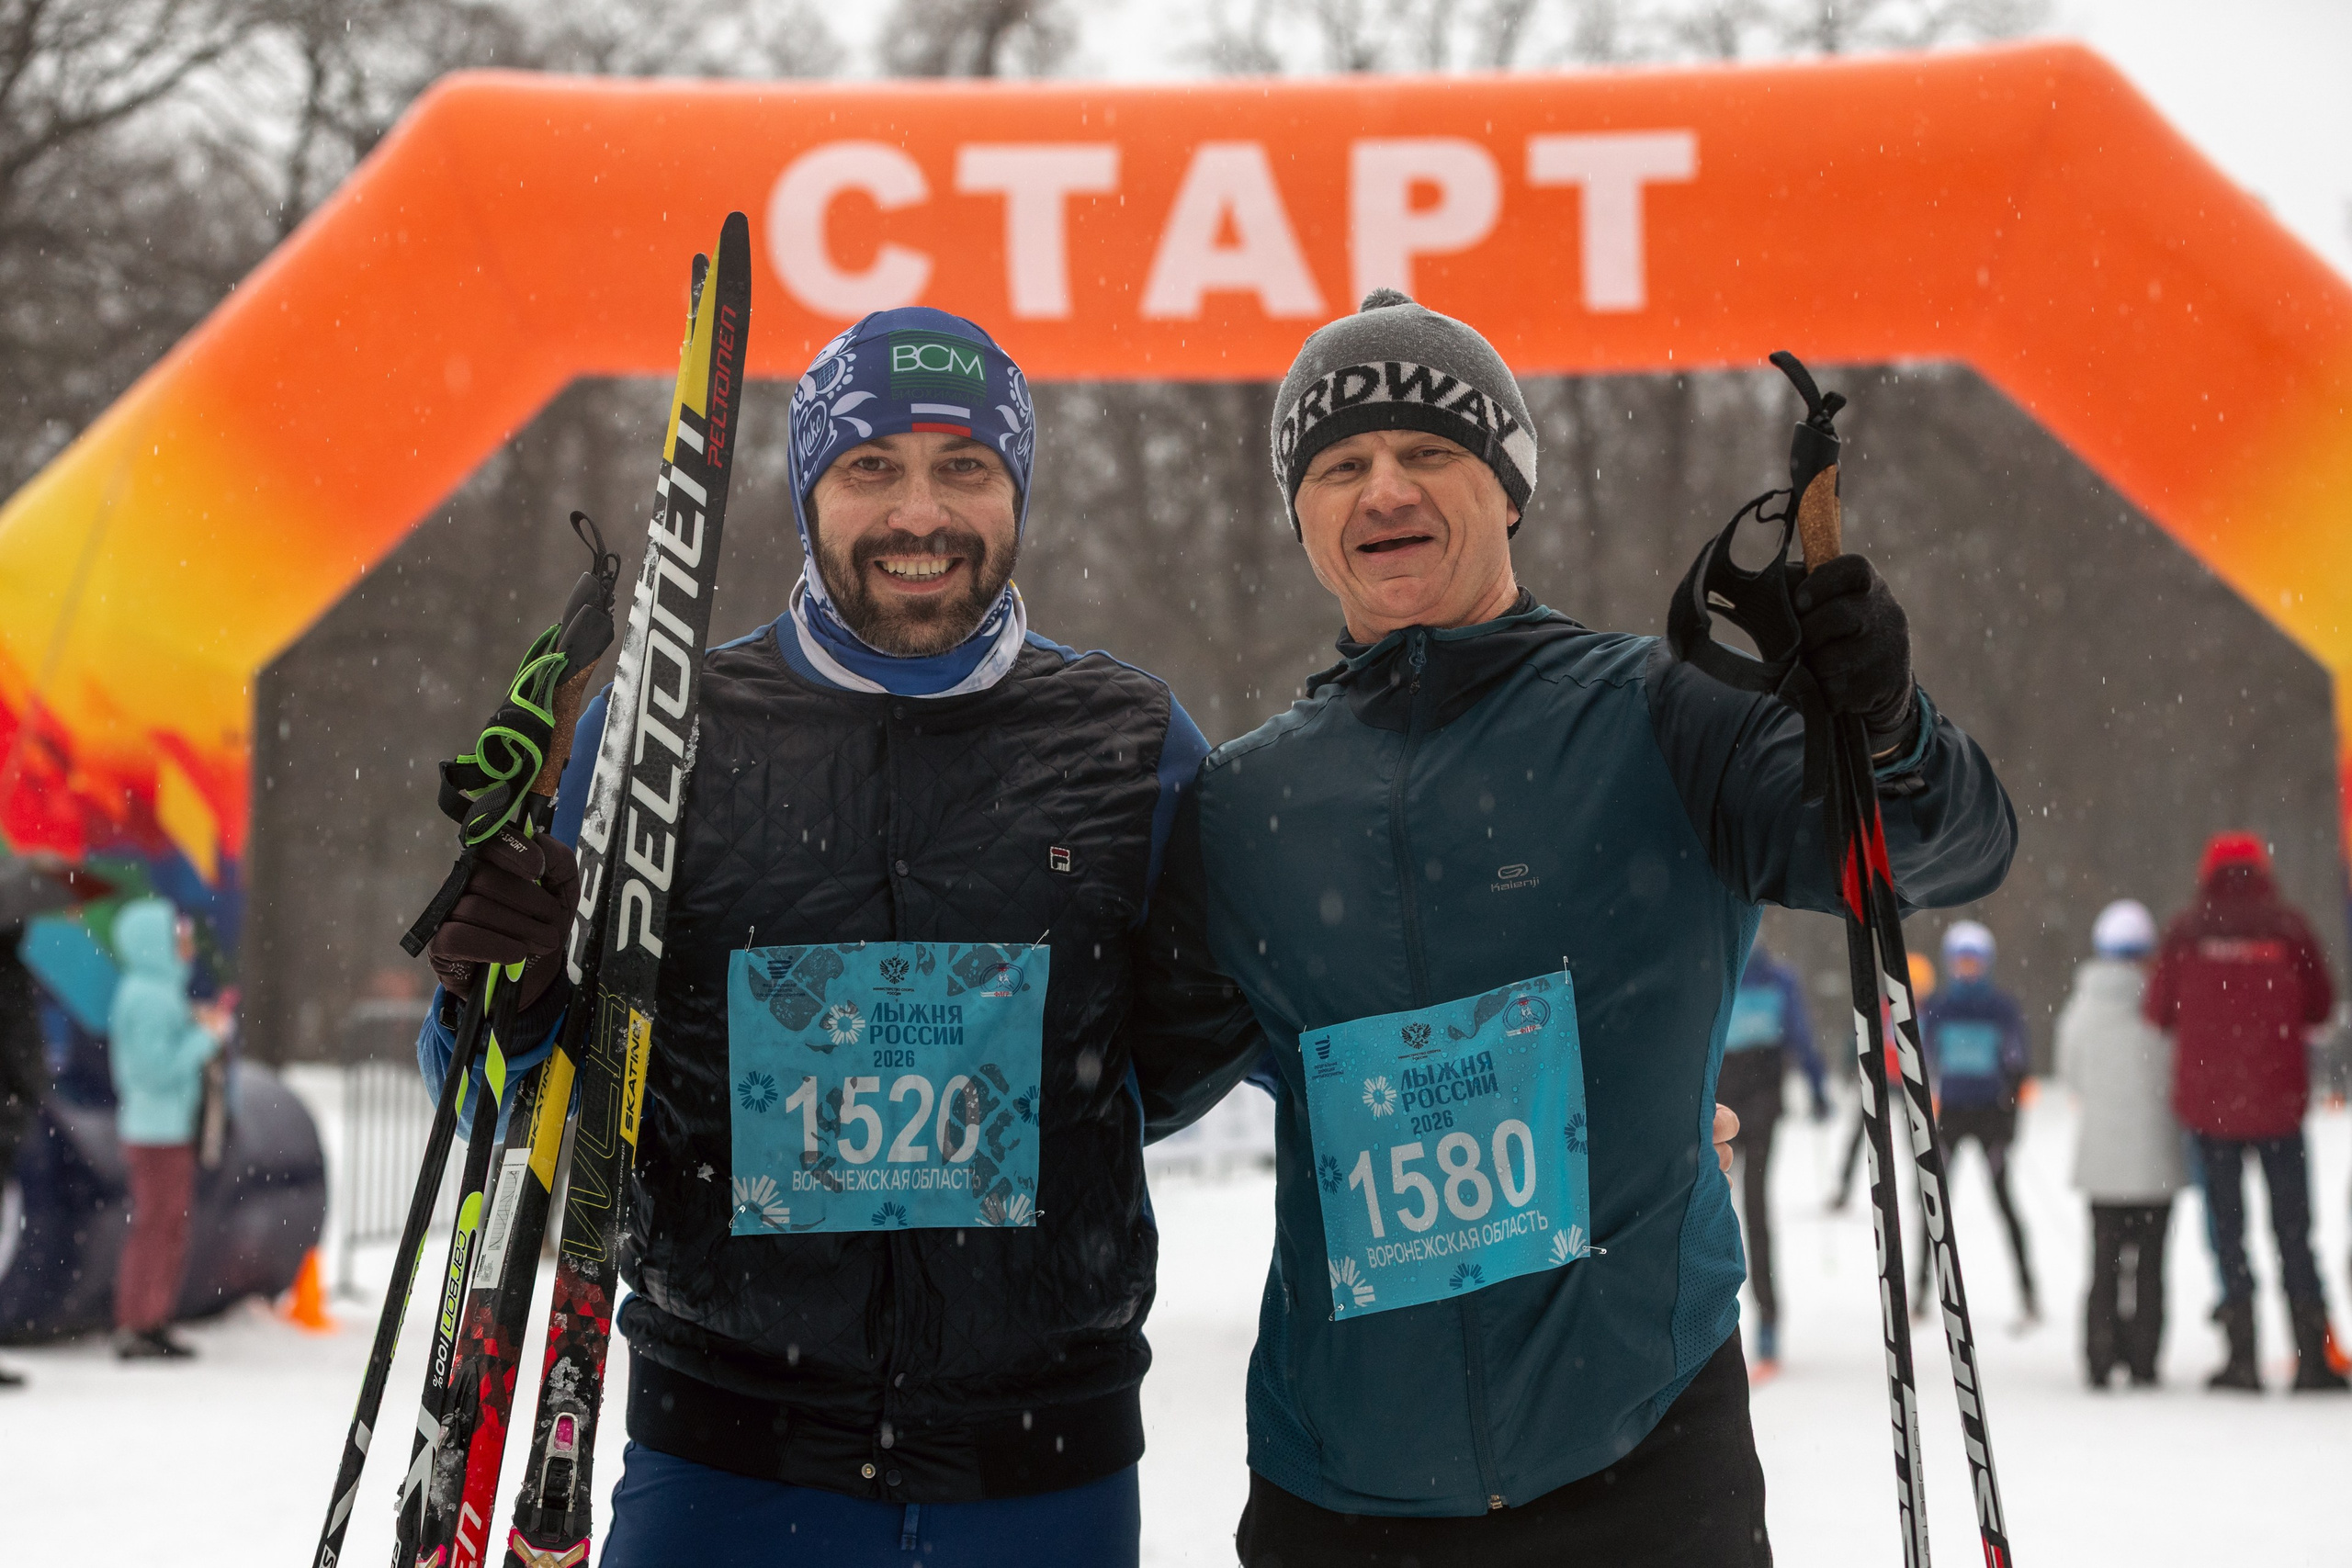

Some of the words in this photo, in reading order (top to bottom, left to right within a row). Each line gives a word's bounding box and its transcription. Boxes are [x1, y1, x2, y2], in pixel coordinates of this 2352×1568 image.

[765, 130, 1698, 321] СТАРТ
[707, 304, 736, 468] PELTONEN
[616, 418, 707, 959] PELTONEN
[1490, 876, 1540, 893] Kalenji
[869, 1002, 964, 1024] ЛЫЖНЯ
[869, 1025, 964, 1045] РОССИИ
[873, 1049, 916, 1068] 2026
[1401, 1050, 1494, 1091] ЛЫЖНЯ
[1401, 1073, 1498, 1113] РОССИИ
[786, 1074, 980, 1165] 1520
[1410, 1110, 1454, 1134] 2026
[792, 1168, 910, 1192] ВОРОНЕЖСКАЯ
[910, 1168, 981, 1190] ОБЛАСТЬ
[1348, 1118, 1537, 1239] 1580
[1366, 1226, 1481, 1269] ВОРОНЕЖСКАЯ
[1481, 1209, 1549, 1246] ОБЛАСТЬ
[1883, 968, 2000, 1534] MADSHUS
[432, 1337, 449, 1389] 100%
